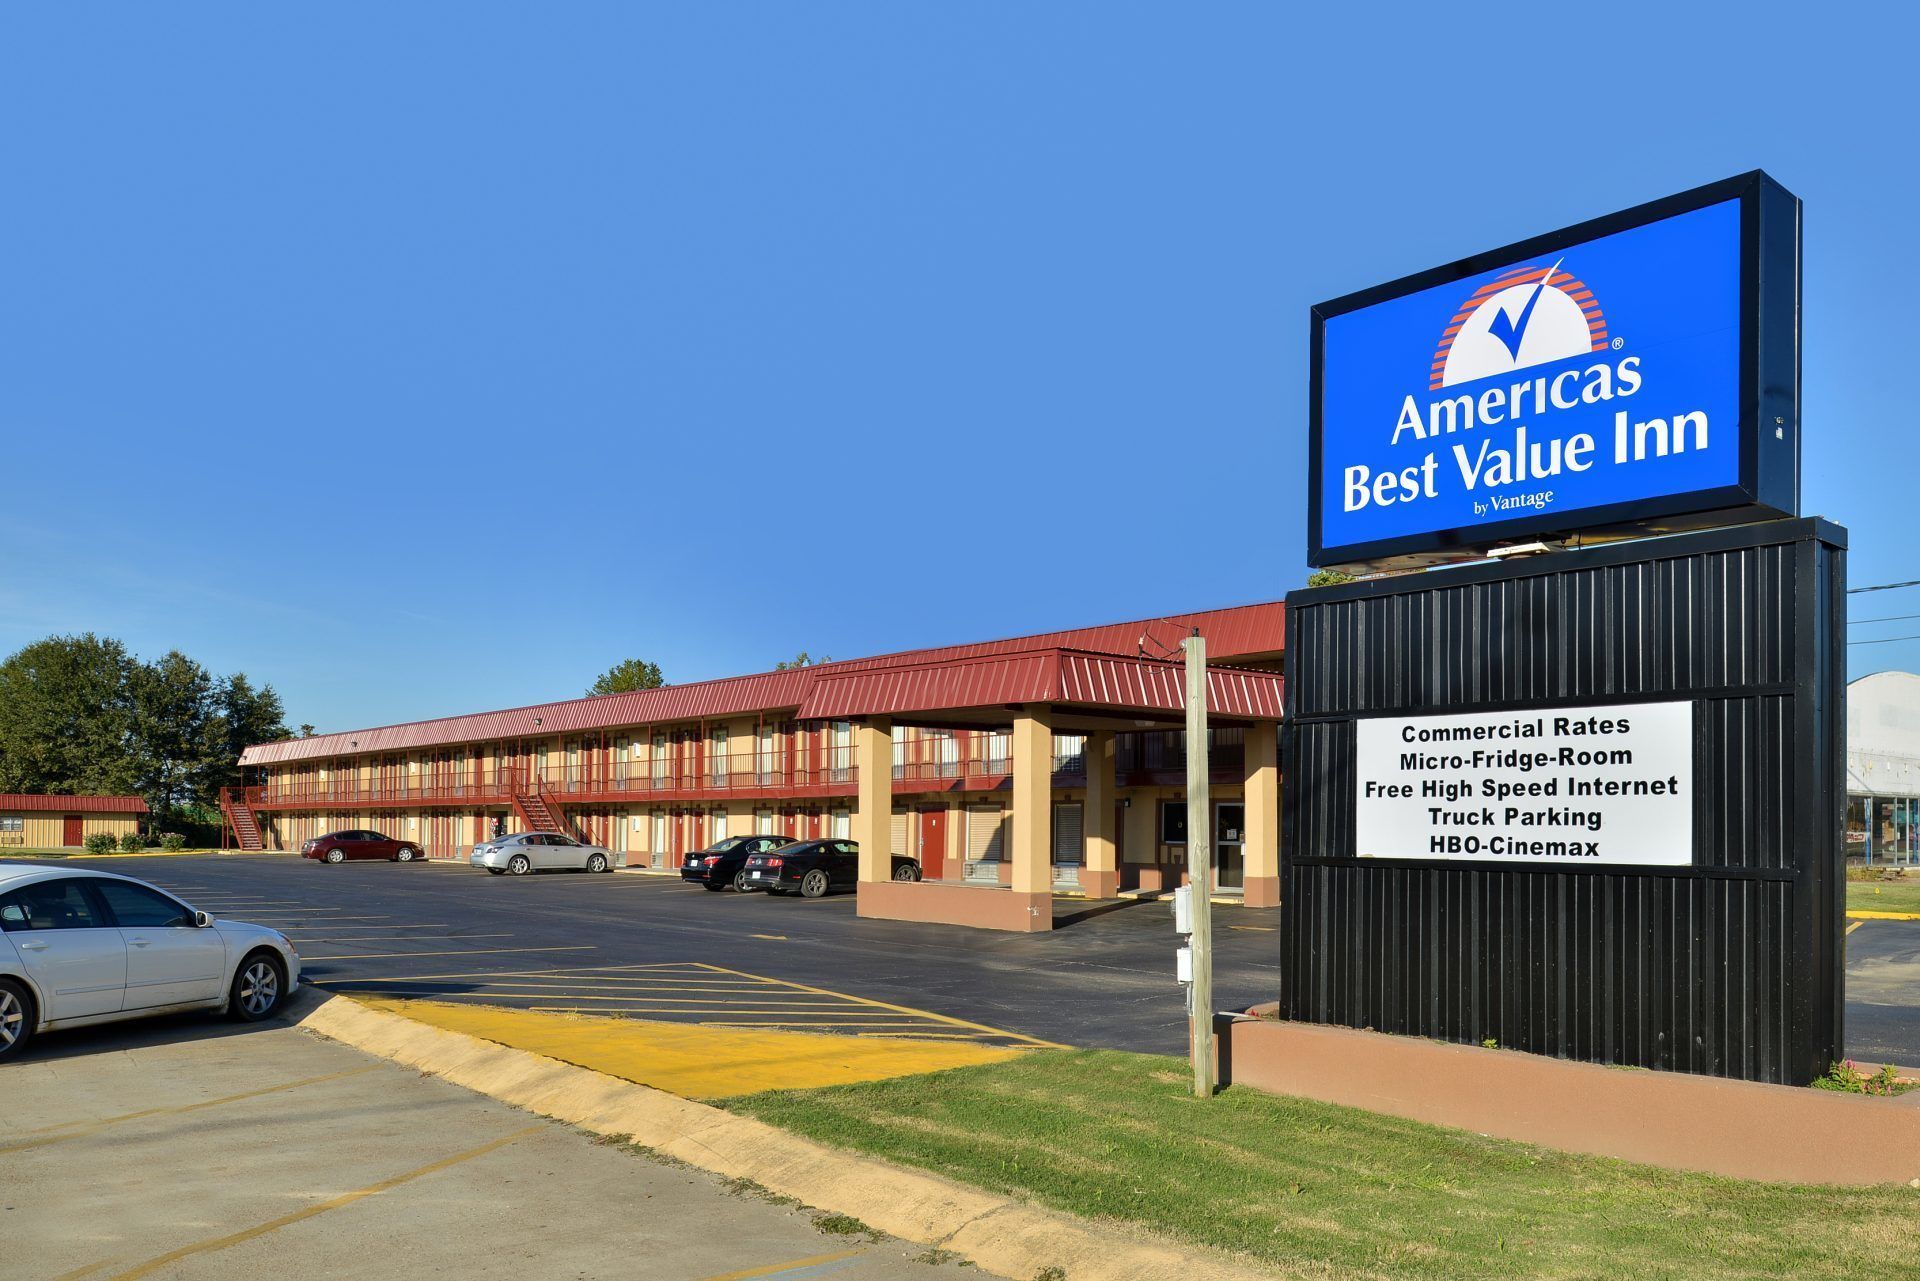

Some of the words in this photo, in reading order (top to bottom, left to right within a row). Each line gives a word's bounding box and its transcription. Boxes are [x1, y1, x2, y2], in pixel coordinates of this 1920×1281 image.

[1390, 356, 1642, 445] Americas
[1343, 452, 1439, 513] Best
[1452, 426, 1595, 491] Value
[1614, 410, 1708, 465] Inn
[1473, 501, 1489, 516] by
[1490, 490, 1554, 511] Vantage
[1401, 718, 1543, 743] Commercial
[1553, 716, 1631, 737] Rates
[1400, 747, 1633, 773] Micro-Fridge-Room
[1365, 780, 1414, 798] Free
[1421, 778, 1473, 802] High
[1481, 777, 1558, 802] Speed
[1568, 775, 1678, 797] Internet
[1428, 807, 1496, 826] Truck
[1504, 807, 1602, 832] Parking
[1430, 835, 1600, 857] HBO-Cinemax
